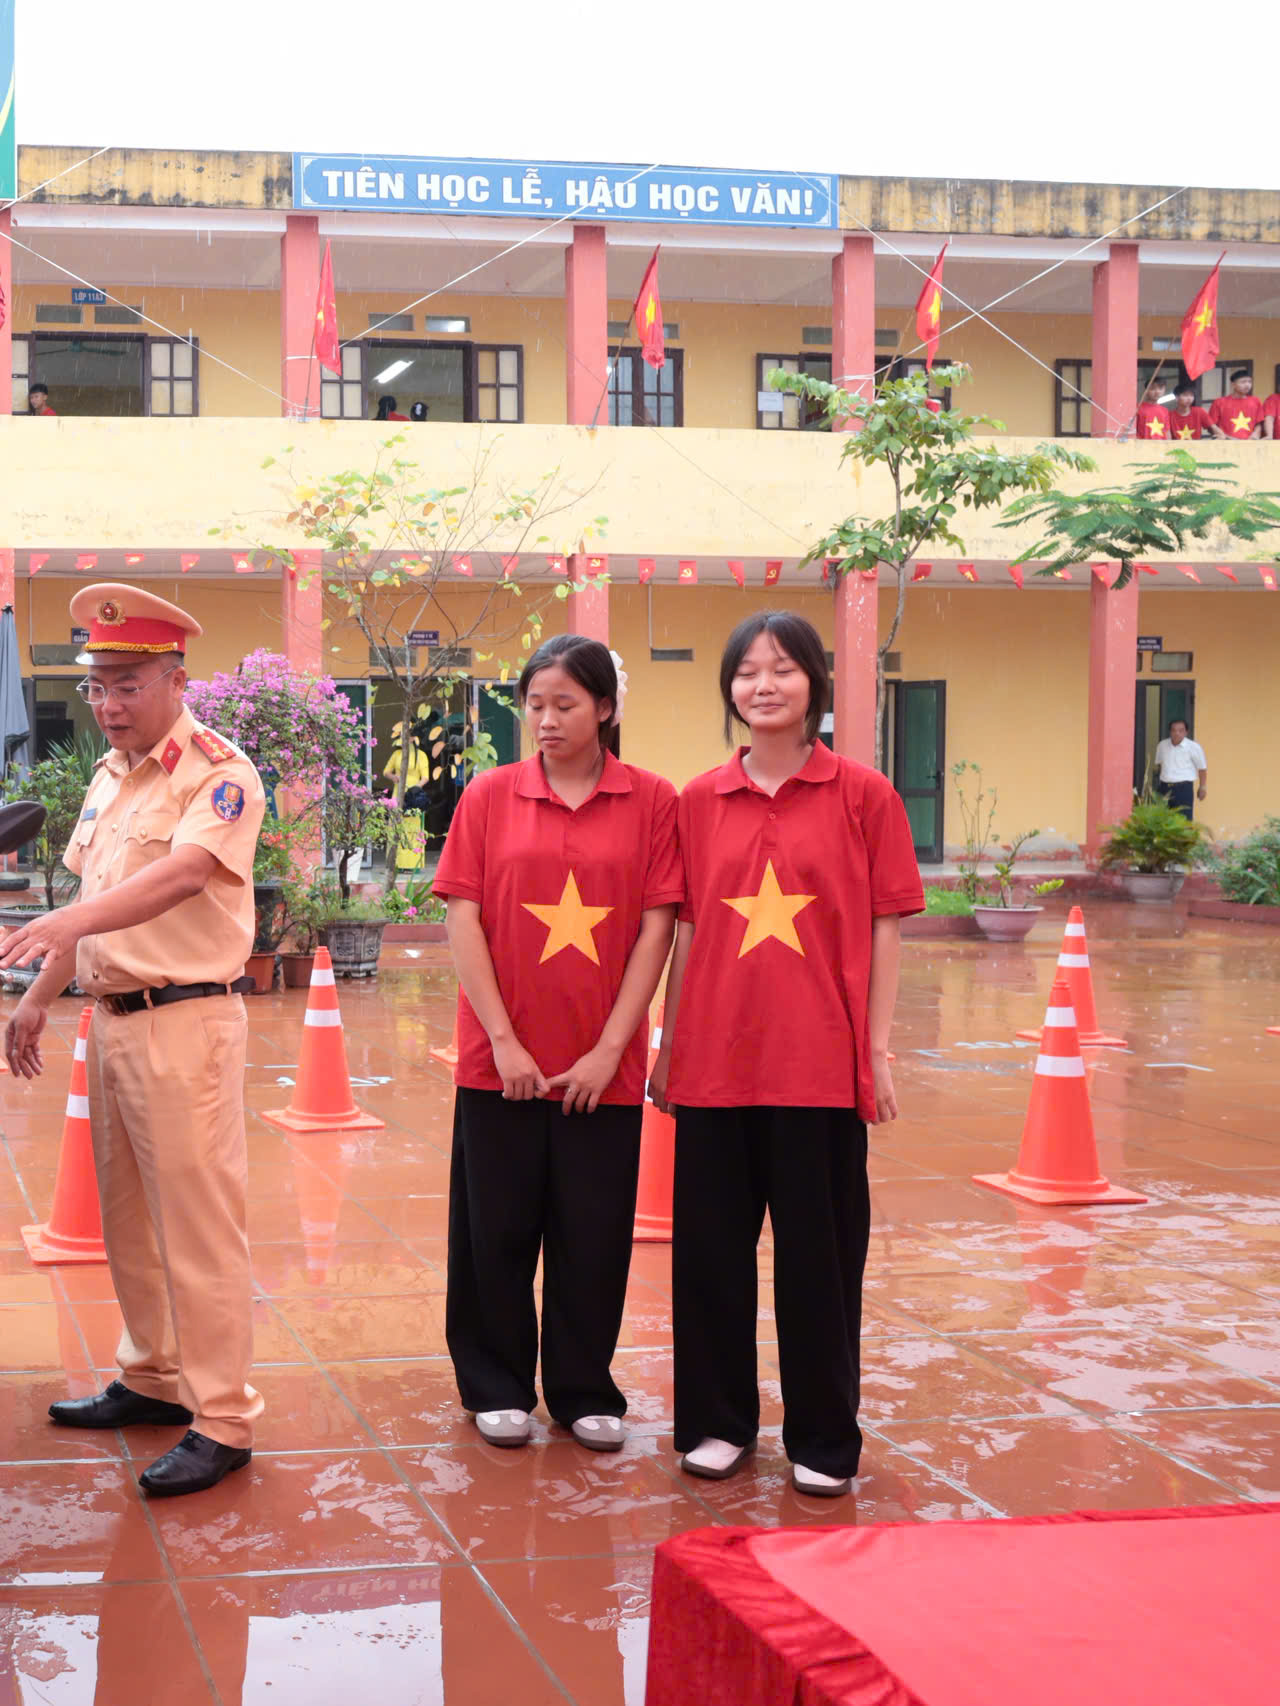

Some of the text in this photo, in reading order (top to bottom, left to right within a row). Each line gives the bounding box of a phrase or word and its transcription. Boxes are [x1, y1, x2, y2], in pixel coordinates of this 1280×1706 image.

[322, 165, 814, 217] TIÊN HỌC LỄ, HẬU HỌC VĂN!
